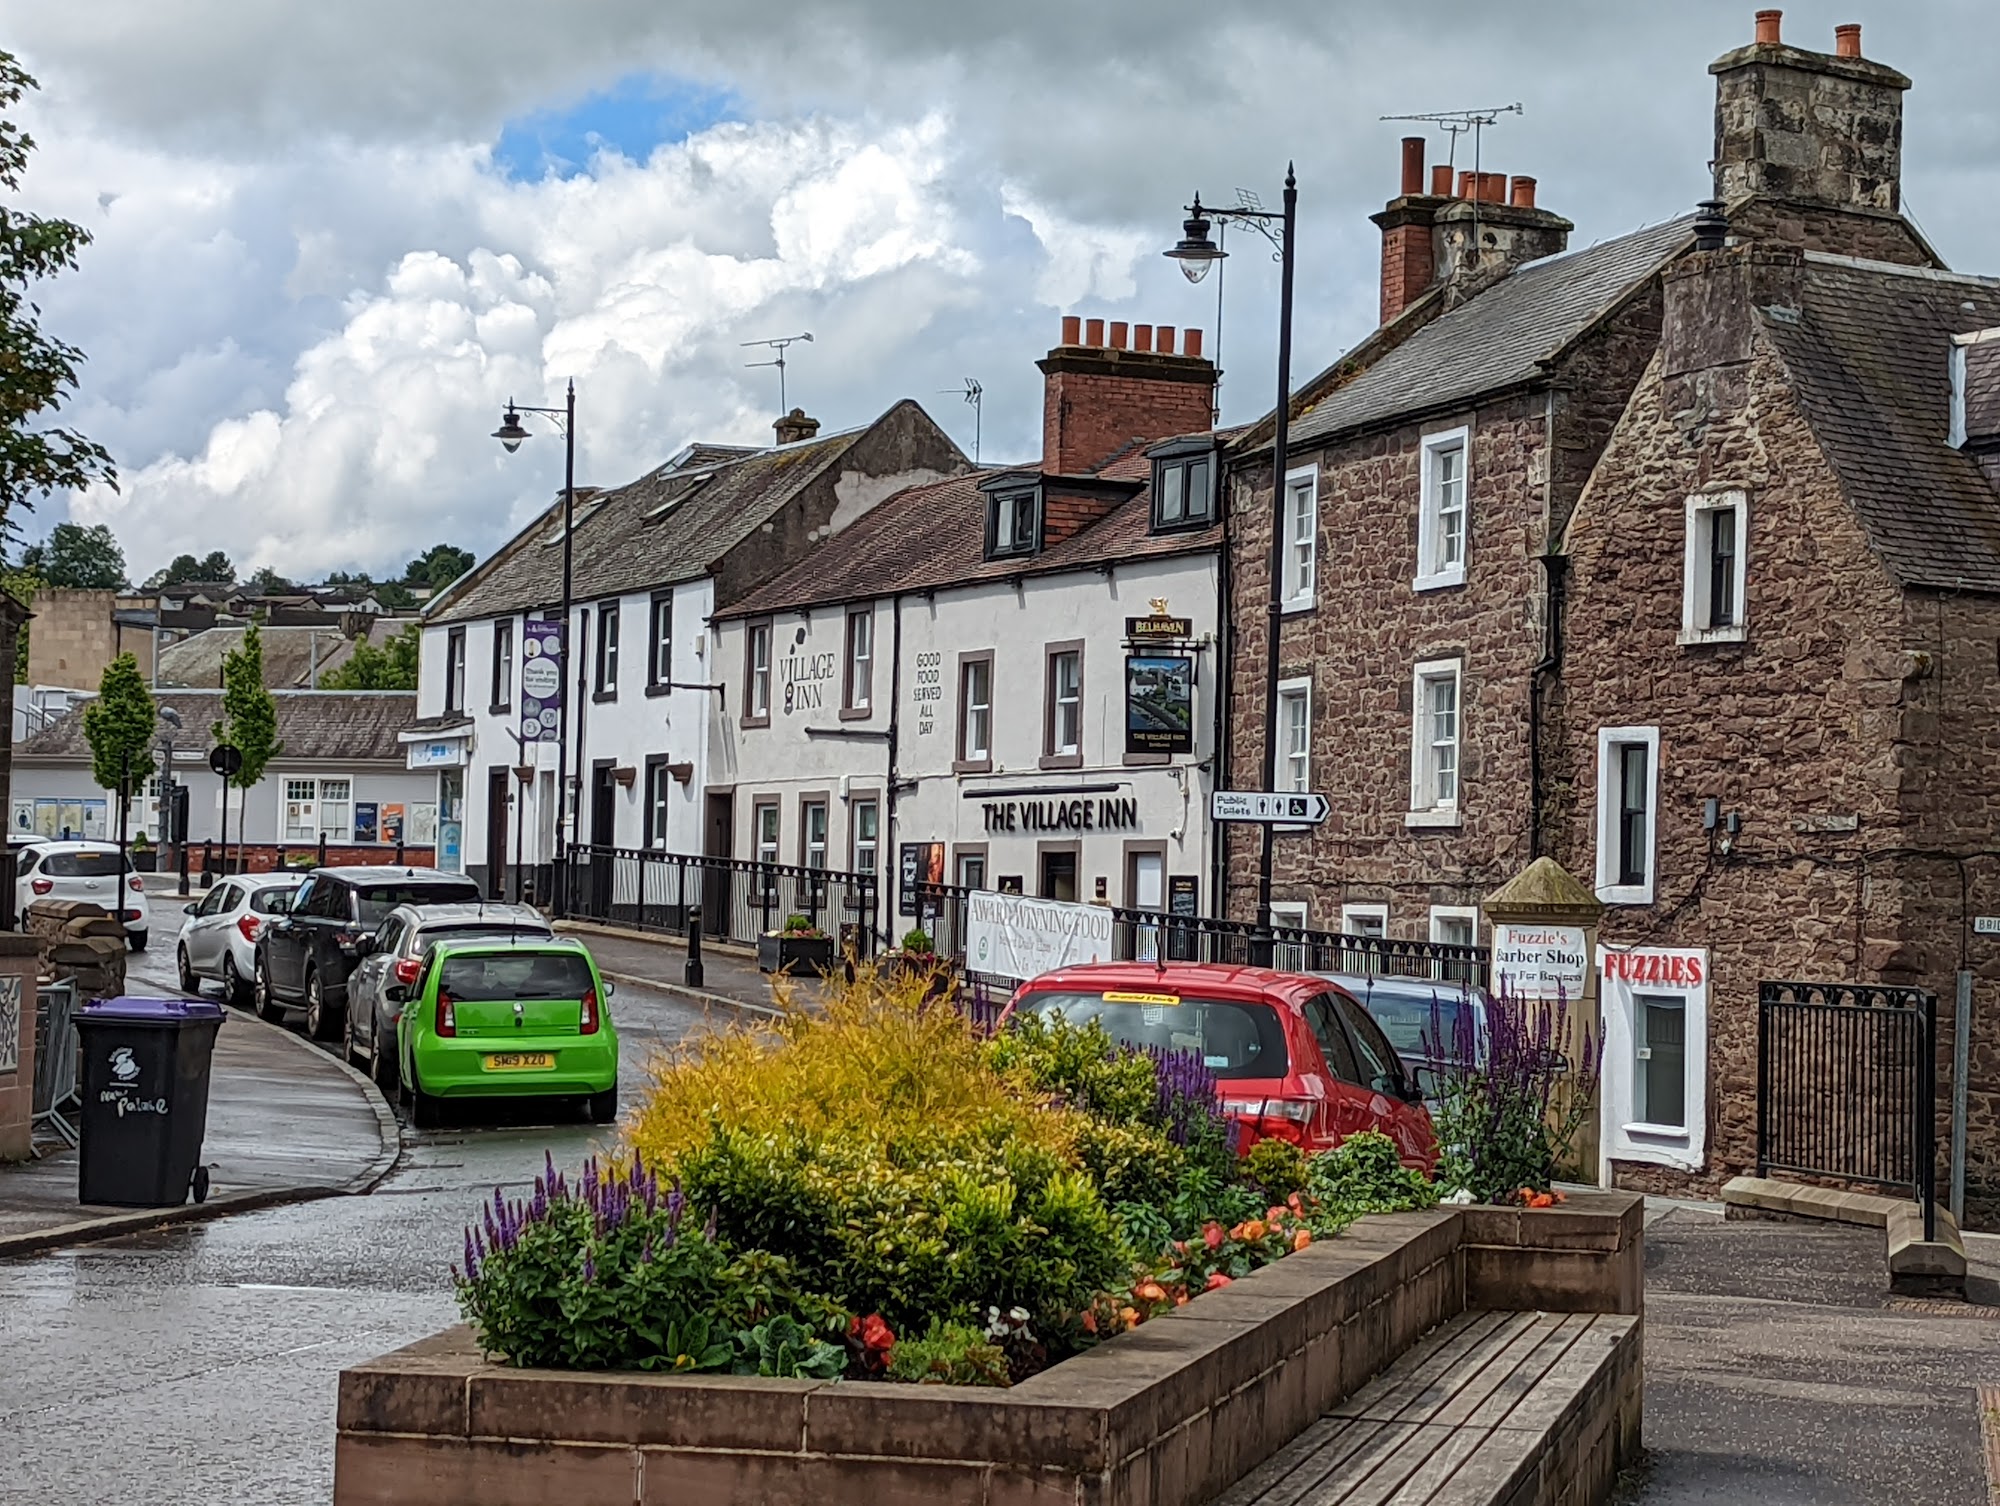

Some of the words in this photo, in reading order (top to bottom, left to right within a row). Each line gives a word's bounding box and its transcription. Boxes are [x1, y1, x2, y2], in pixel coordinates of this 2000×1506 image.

[779, 653, 835, 682] VILLAGE
[916, 652, 941, 668] GOOD
[917, 669, 940, 684] FOOD
[796, 683, 823, 710] INN
[913, 686, 942, 701] SERVED
[919, 703, 934, 718] ALL
[919, 721, 934, 736] DAY
[1216, 795, 1248, 806] Public
[981, 803, 1017, 832] THE
[1019, 800, 1095, 832] VILLAGE
[1098, 798, 1138, 830] INN
[1216, 805, 1251, 817] Toilets
[971, 899, 1013, 926] AWARD
[1013, 903, 1072, 935] WINNING
[1072, 910, 1110, 940] FOOD
[1496, 948, 1542, 963] Barber
[1545, 949, 1584, 968] Shop
